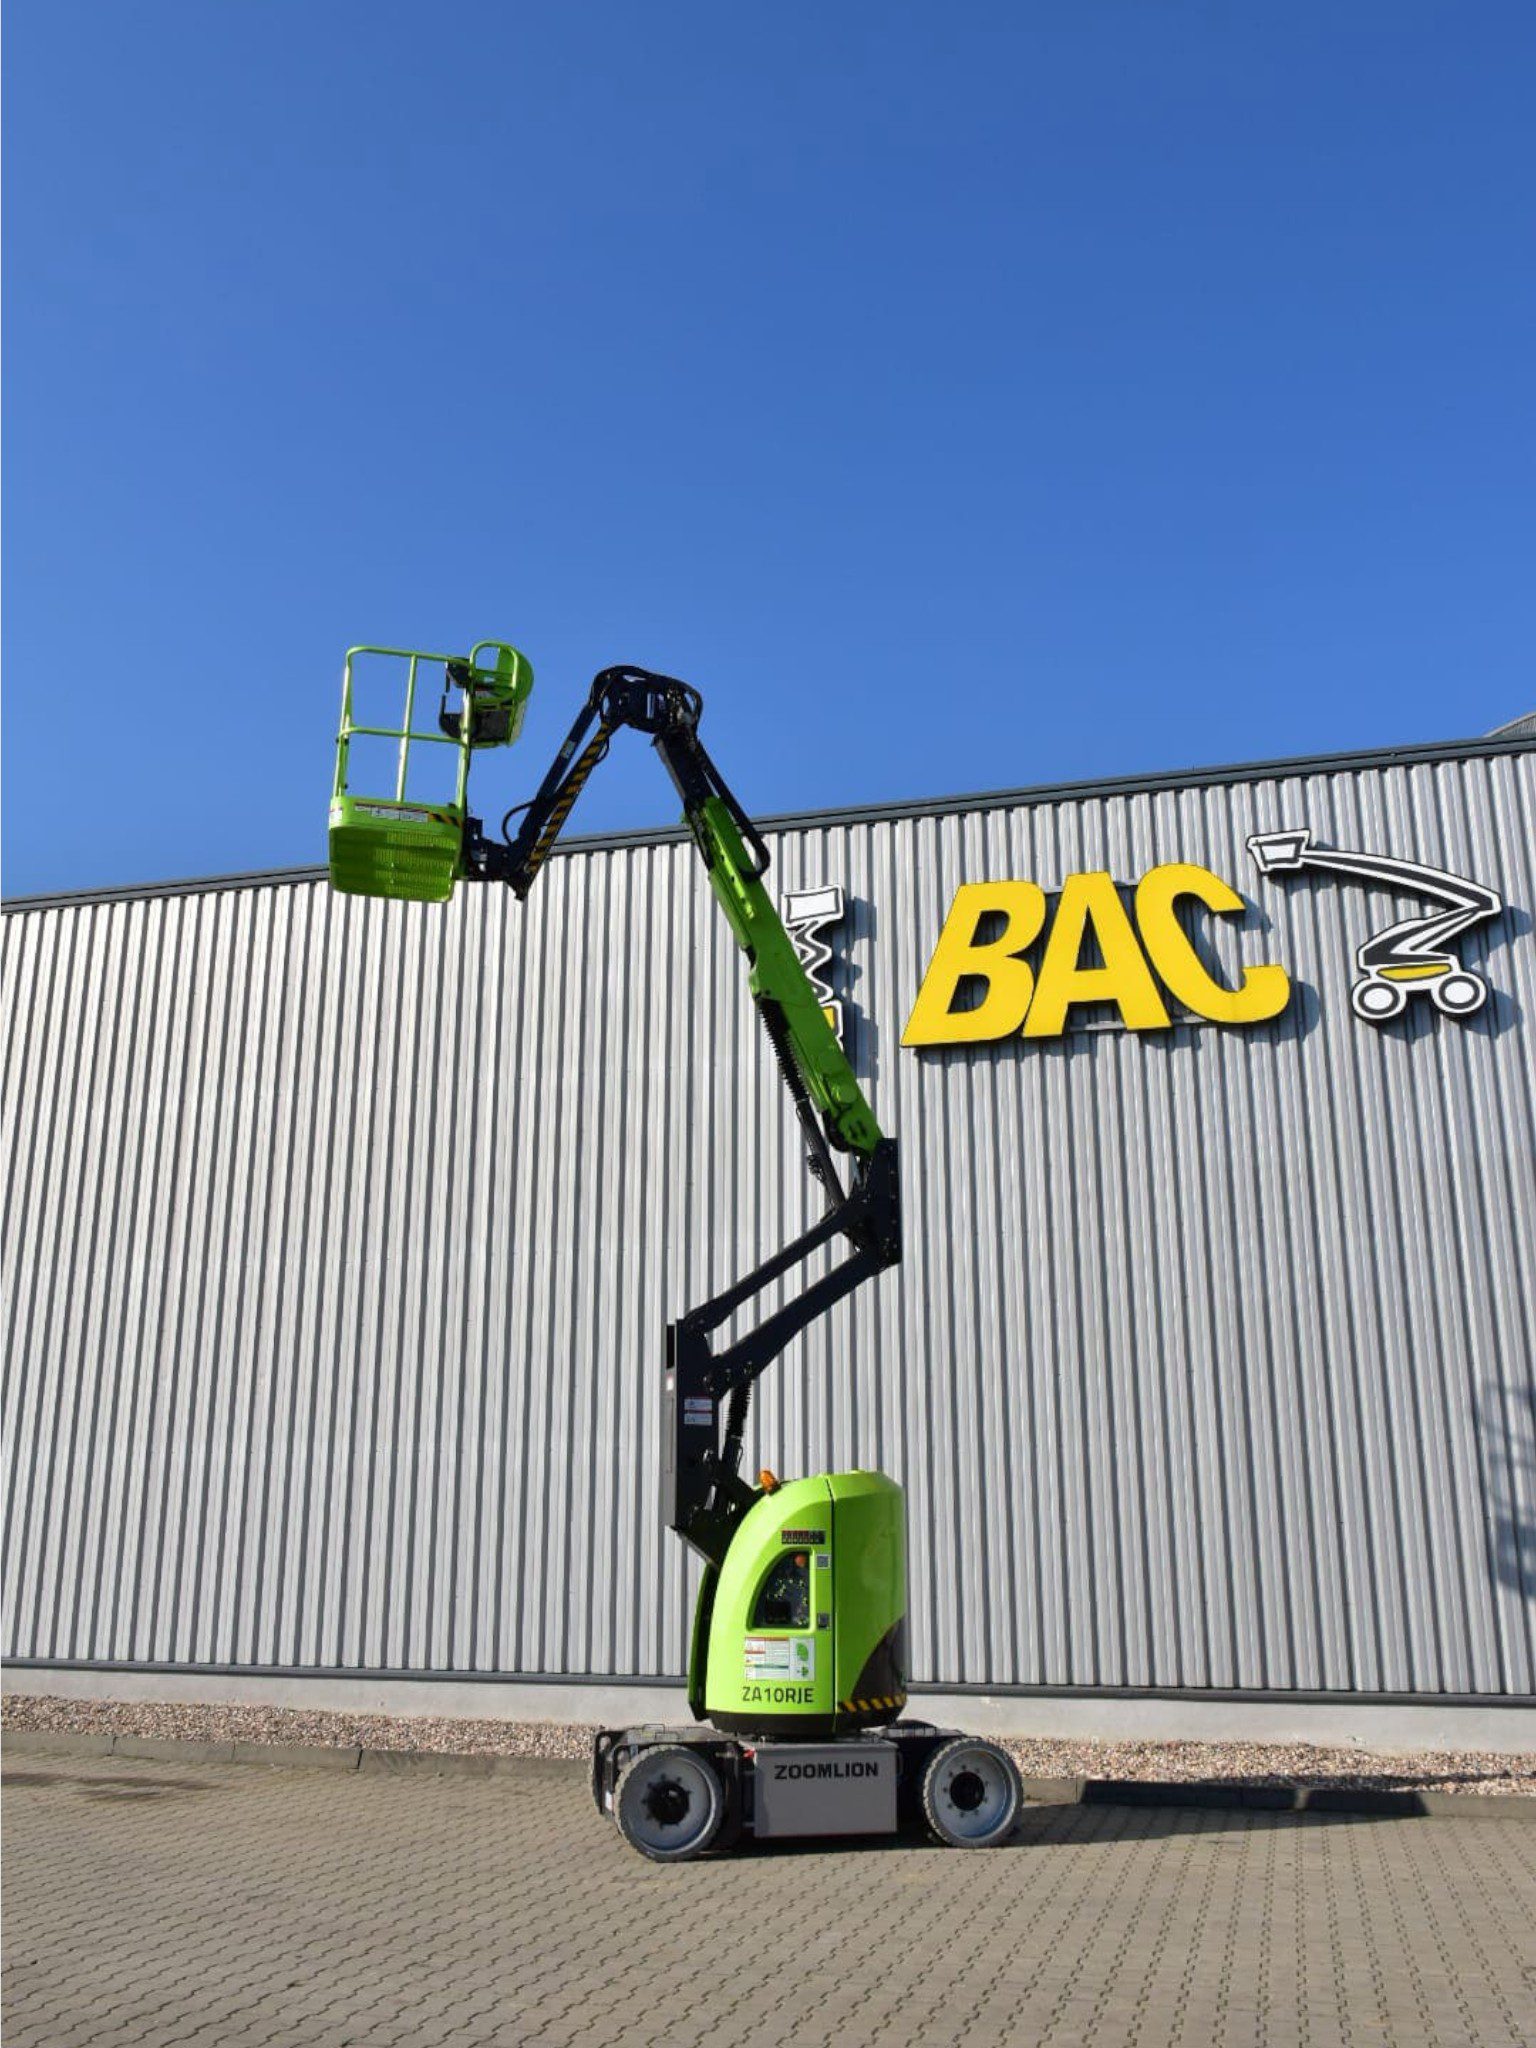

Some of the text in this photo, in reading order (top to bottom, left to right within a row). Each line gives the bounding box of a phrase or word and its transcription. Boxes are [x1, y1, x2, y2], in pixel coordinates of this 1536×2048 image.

[901, 862, 1291, 1047] BAC
[742, 1686, 815, 1704] ZA10RJE
[774, 1761, 879, 1780] ZOOMLION
